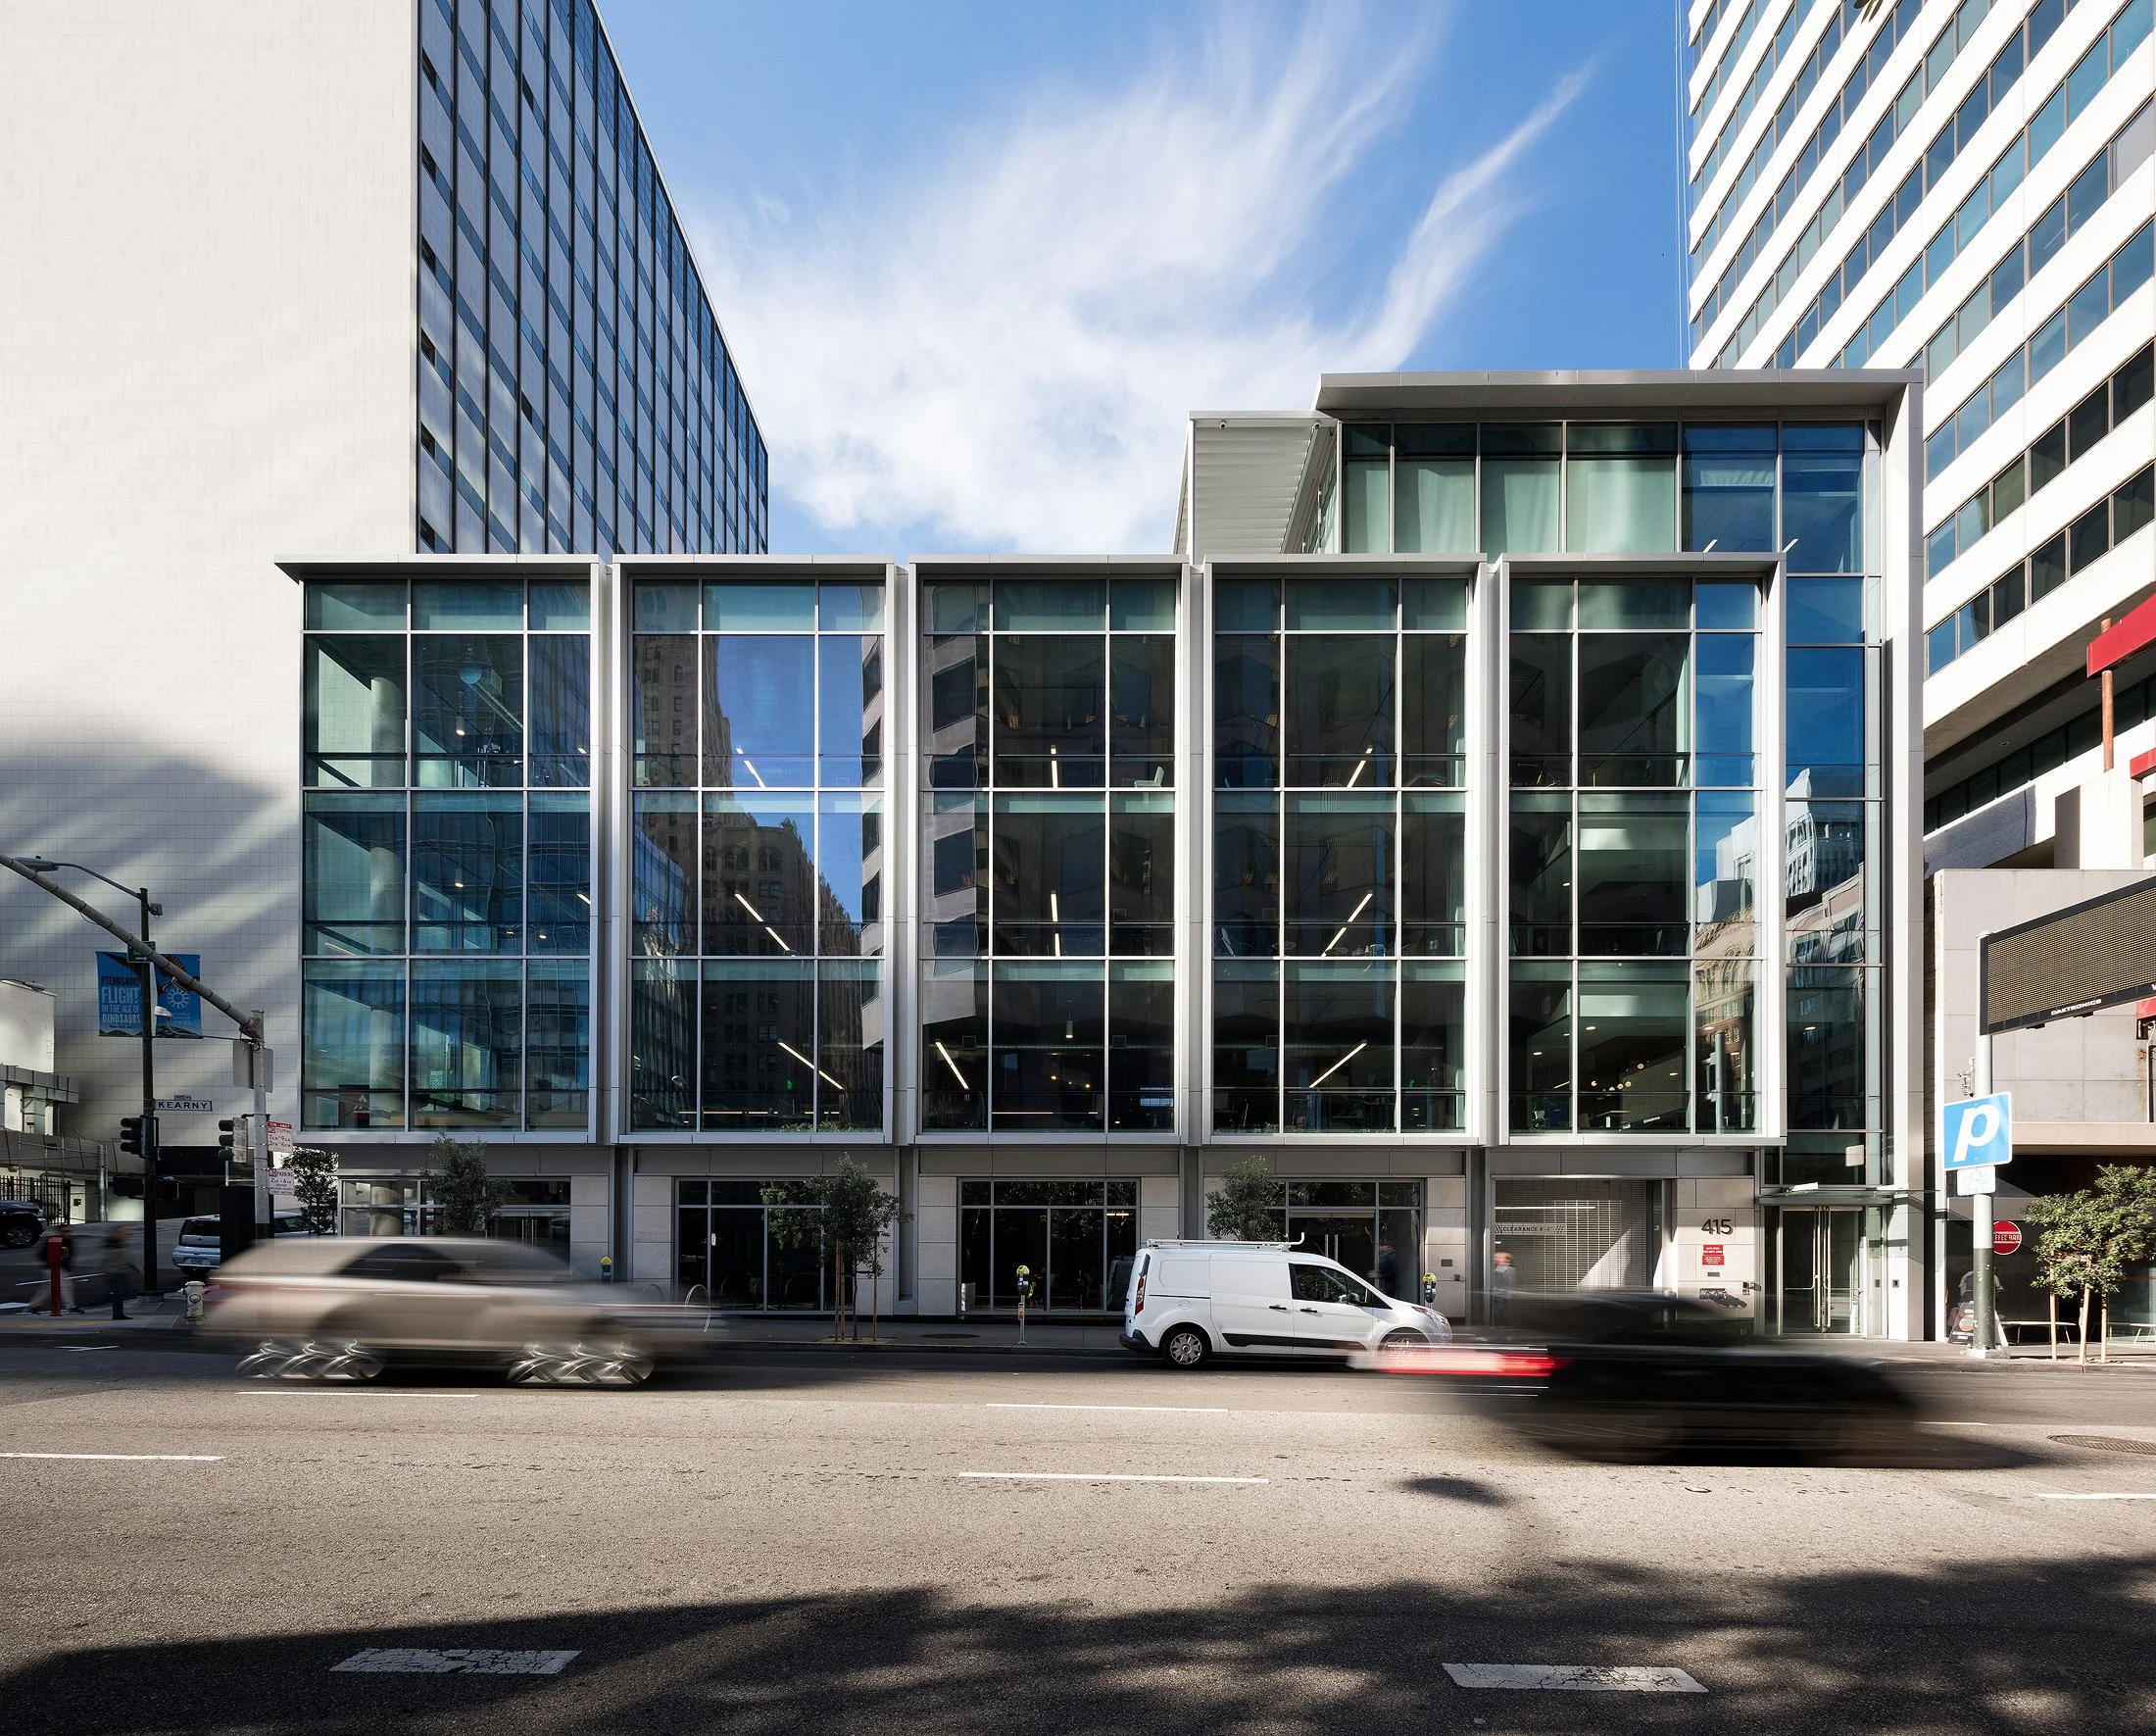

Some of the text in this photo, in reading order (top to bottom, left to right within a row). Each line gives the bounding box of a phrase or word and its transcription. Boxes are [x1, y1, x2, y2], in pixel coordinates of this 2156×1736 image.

[101, 976, 140, 986] PTEROSAURS
[101, 987, 140, 1005] FLIGHT
[101, 1005, 140, 1014] IN THE AGE OF
[2050, 999, 2102, 1016] DAKTRONICS
[102, 1014, 141, 1024] DINOSAURS
[158, 1101, 208, 1110] KEARNY
[1701, 1218, 1734, 1235] 415
